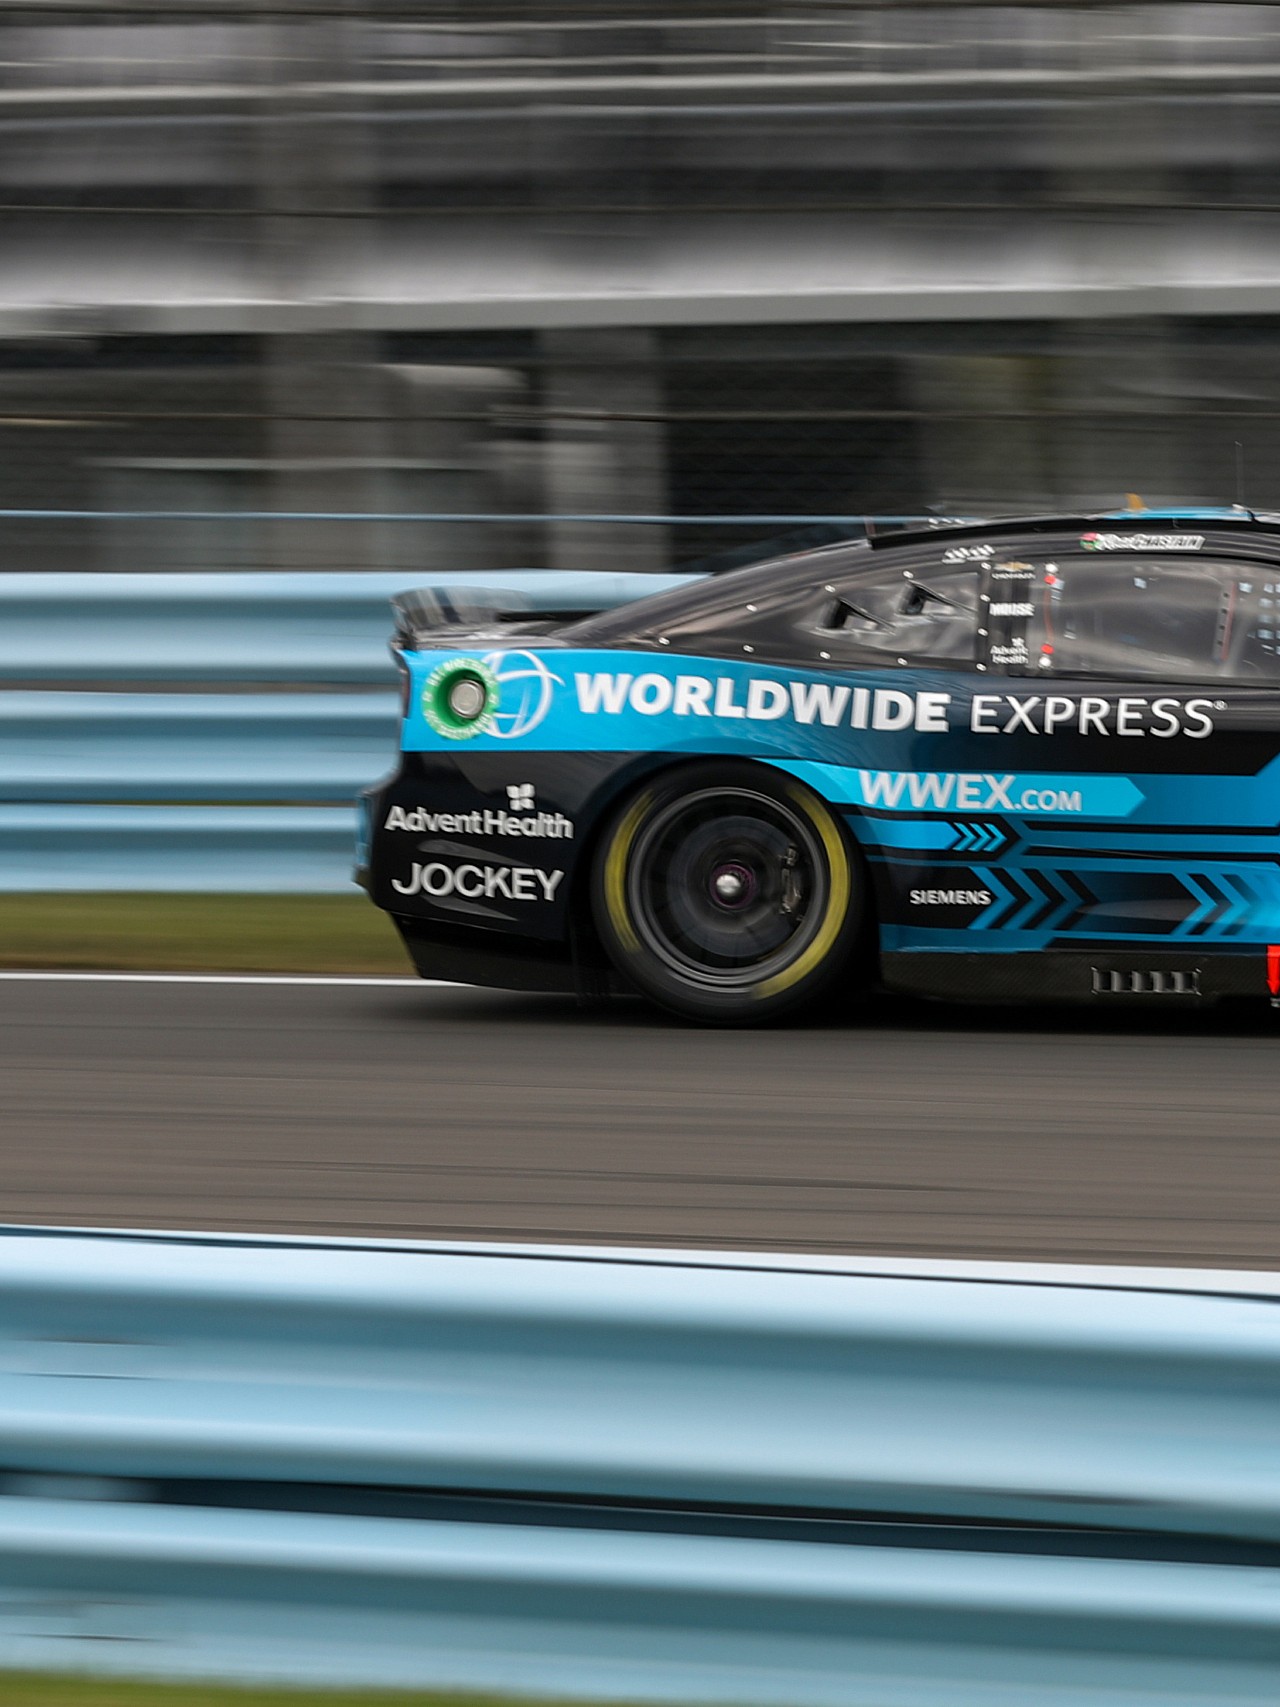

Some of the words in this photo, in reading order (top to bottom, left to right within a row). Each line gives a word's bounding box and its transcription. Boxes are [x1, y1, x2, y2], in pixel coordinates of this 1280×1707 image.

[574, 672, 951, 733] WORLDWIDE
[858, 769, 1083, 811] WWEX.COM
[384, 805, 574, 839] AdventHealth
[391, 862, 565, 901] JOCKEY
[910, 890, 991, 905] SIEMENS
